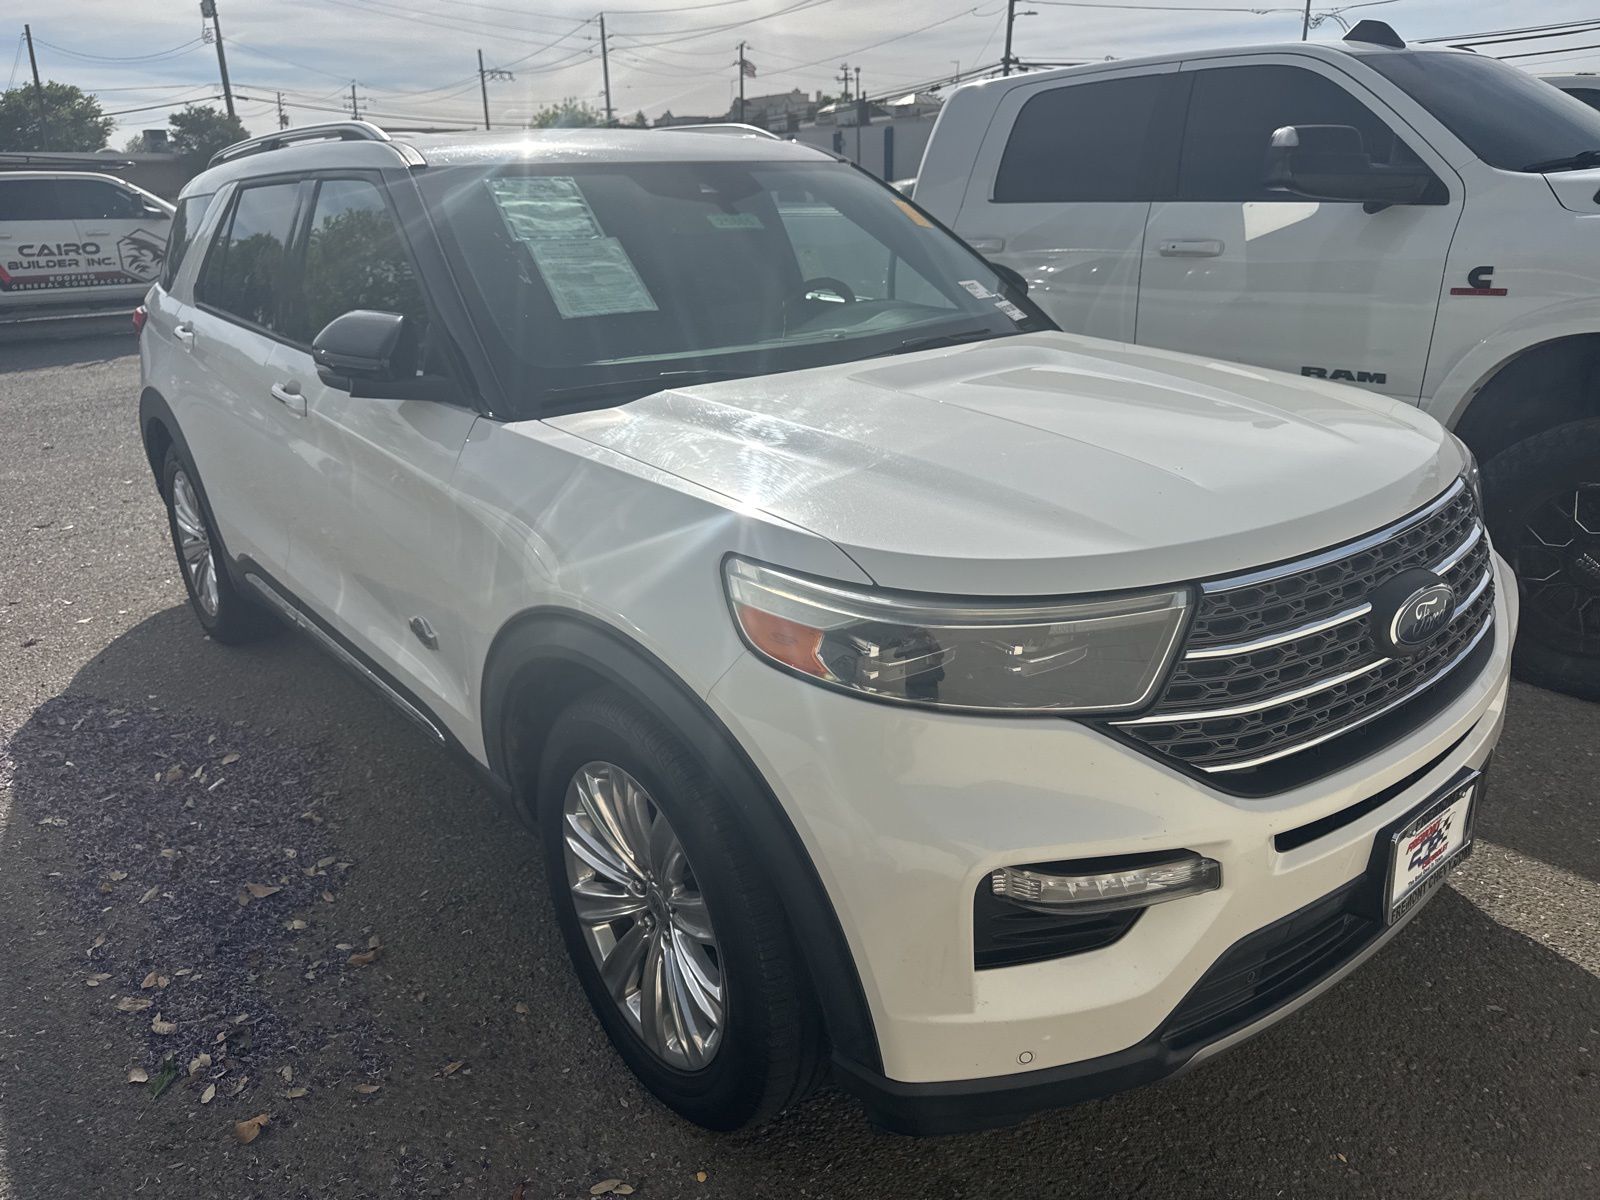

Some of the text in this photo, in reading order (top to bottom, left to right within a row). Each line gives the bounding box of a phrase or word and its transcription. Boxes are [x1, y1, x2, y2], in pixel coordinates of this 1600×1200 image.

[18, 242, 100, 257] CAIRO
[8, 257, 116, 270] BUILDER INC.
[11, 277, 133, 290] GENERAL CONTRACTOR
[49, 273, 96, 282] ROOFING
[1301, 366, 1387, 385] RAM
[1412, 596, 1447, 634] Ford
[1391, 880, 1428, 923] FREMONT
